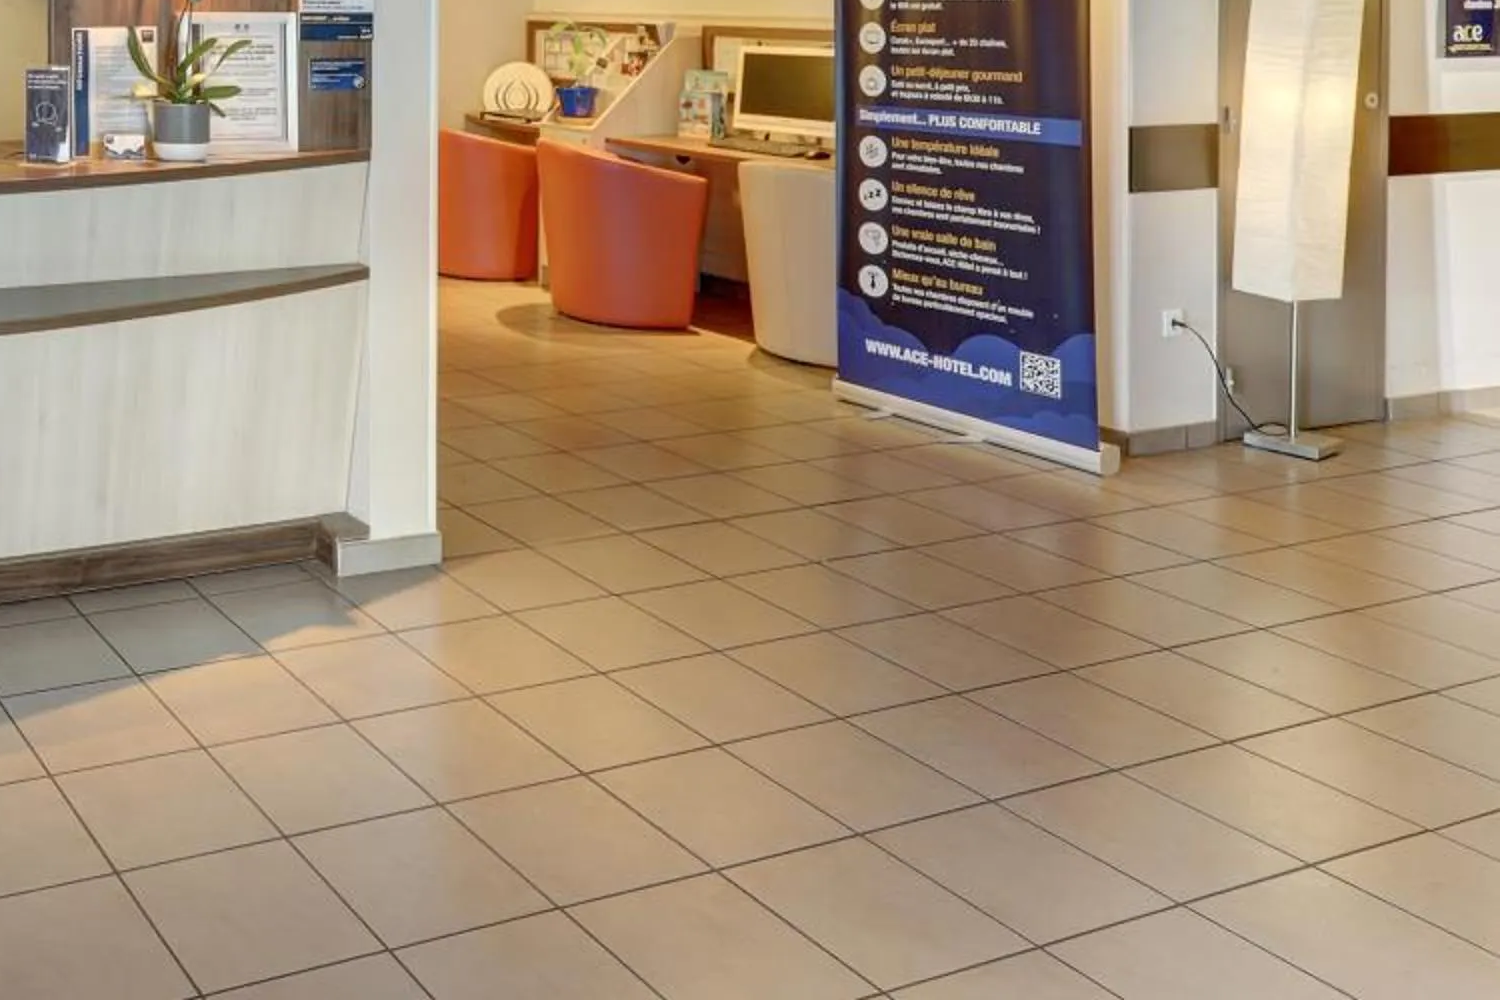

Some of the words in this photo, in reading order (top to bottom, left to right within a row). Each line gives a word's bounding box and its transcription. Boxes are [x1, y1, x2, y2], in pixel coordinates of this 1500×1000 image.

[1453, 24, 1483, 42] ace
[971, 70, 1023, 86] gourmand
[928, 113, 957, 128] PLUS
[959, 116, 1041, 136] CONFORTABLE
[865, 337, 1013, 387] WWW.ACE-HOTEL.COM
